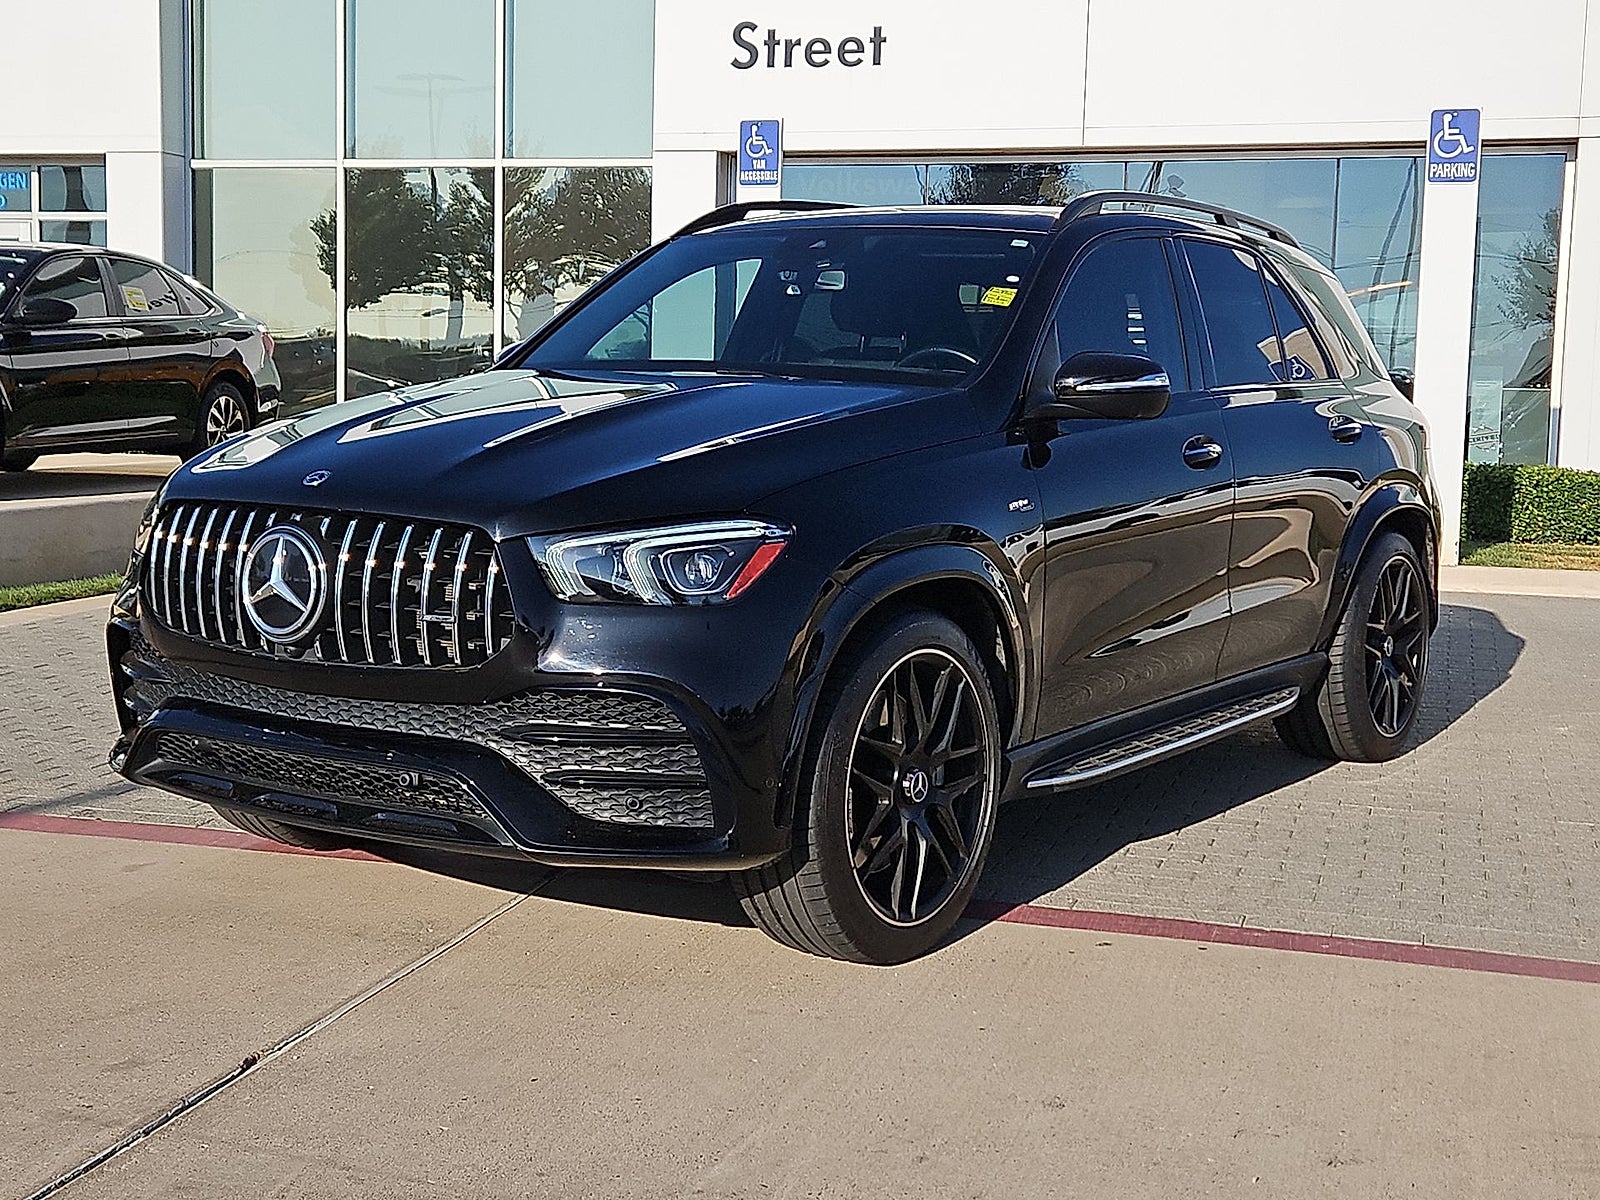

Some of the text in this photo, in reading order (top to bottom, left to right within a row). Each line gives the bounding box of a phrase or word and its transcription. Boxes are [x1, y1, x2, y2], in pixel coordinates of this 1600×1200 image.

[731, 21, 887, 69] Street
[740, 170, 778, 181] ACCESSIBLE
[1429, 162, 1476, 178] PARKING
